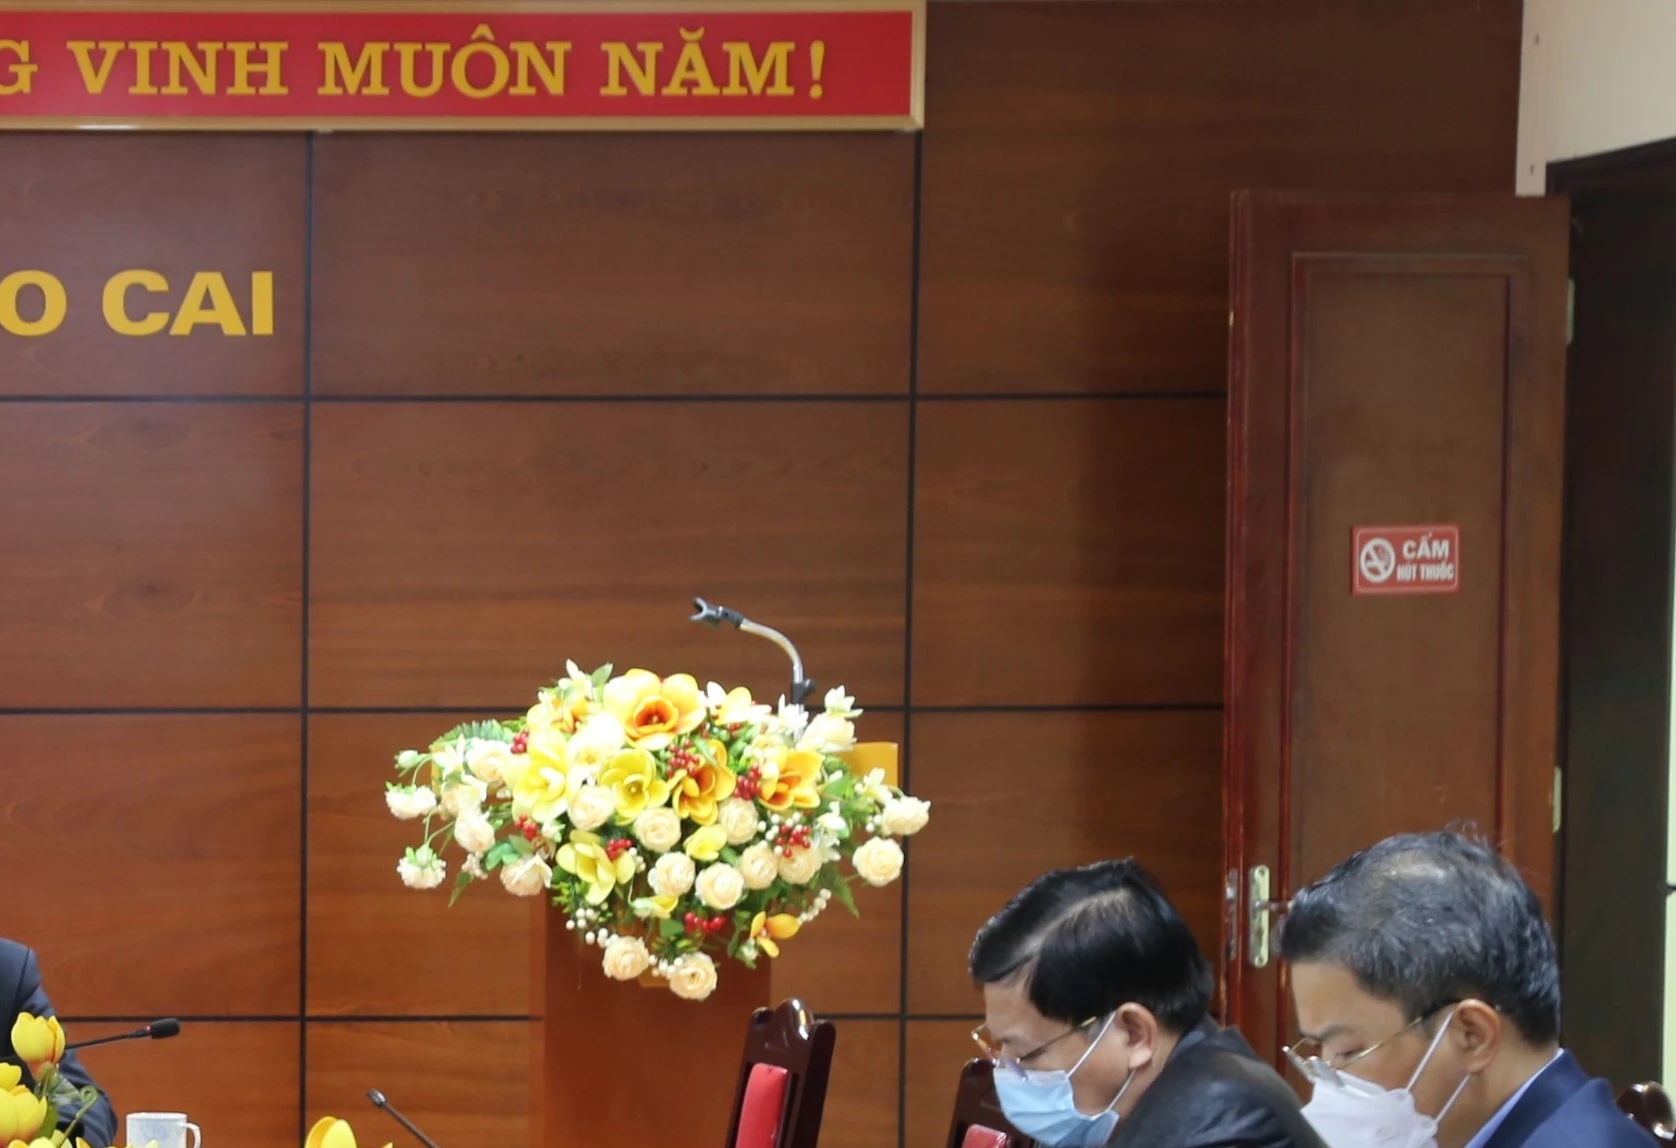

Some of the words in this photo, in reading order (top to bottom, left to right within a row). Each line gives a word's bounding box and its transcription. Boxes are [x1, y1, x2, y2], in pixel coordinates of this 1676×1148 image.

[67, 41, 289, 95] VINH
[318, 24, 572, 98] MUÔN
[601, 25, 825, 98] NĂM!
[104, 269, 274, 337] CAI
[1402, 532, 1450, 560] CẤM
